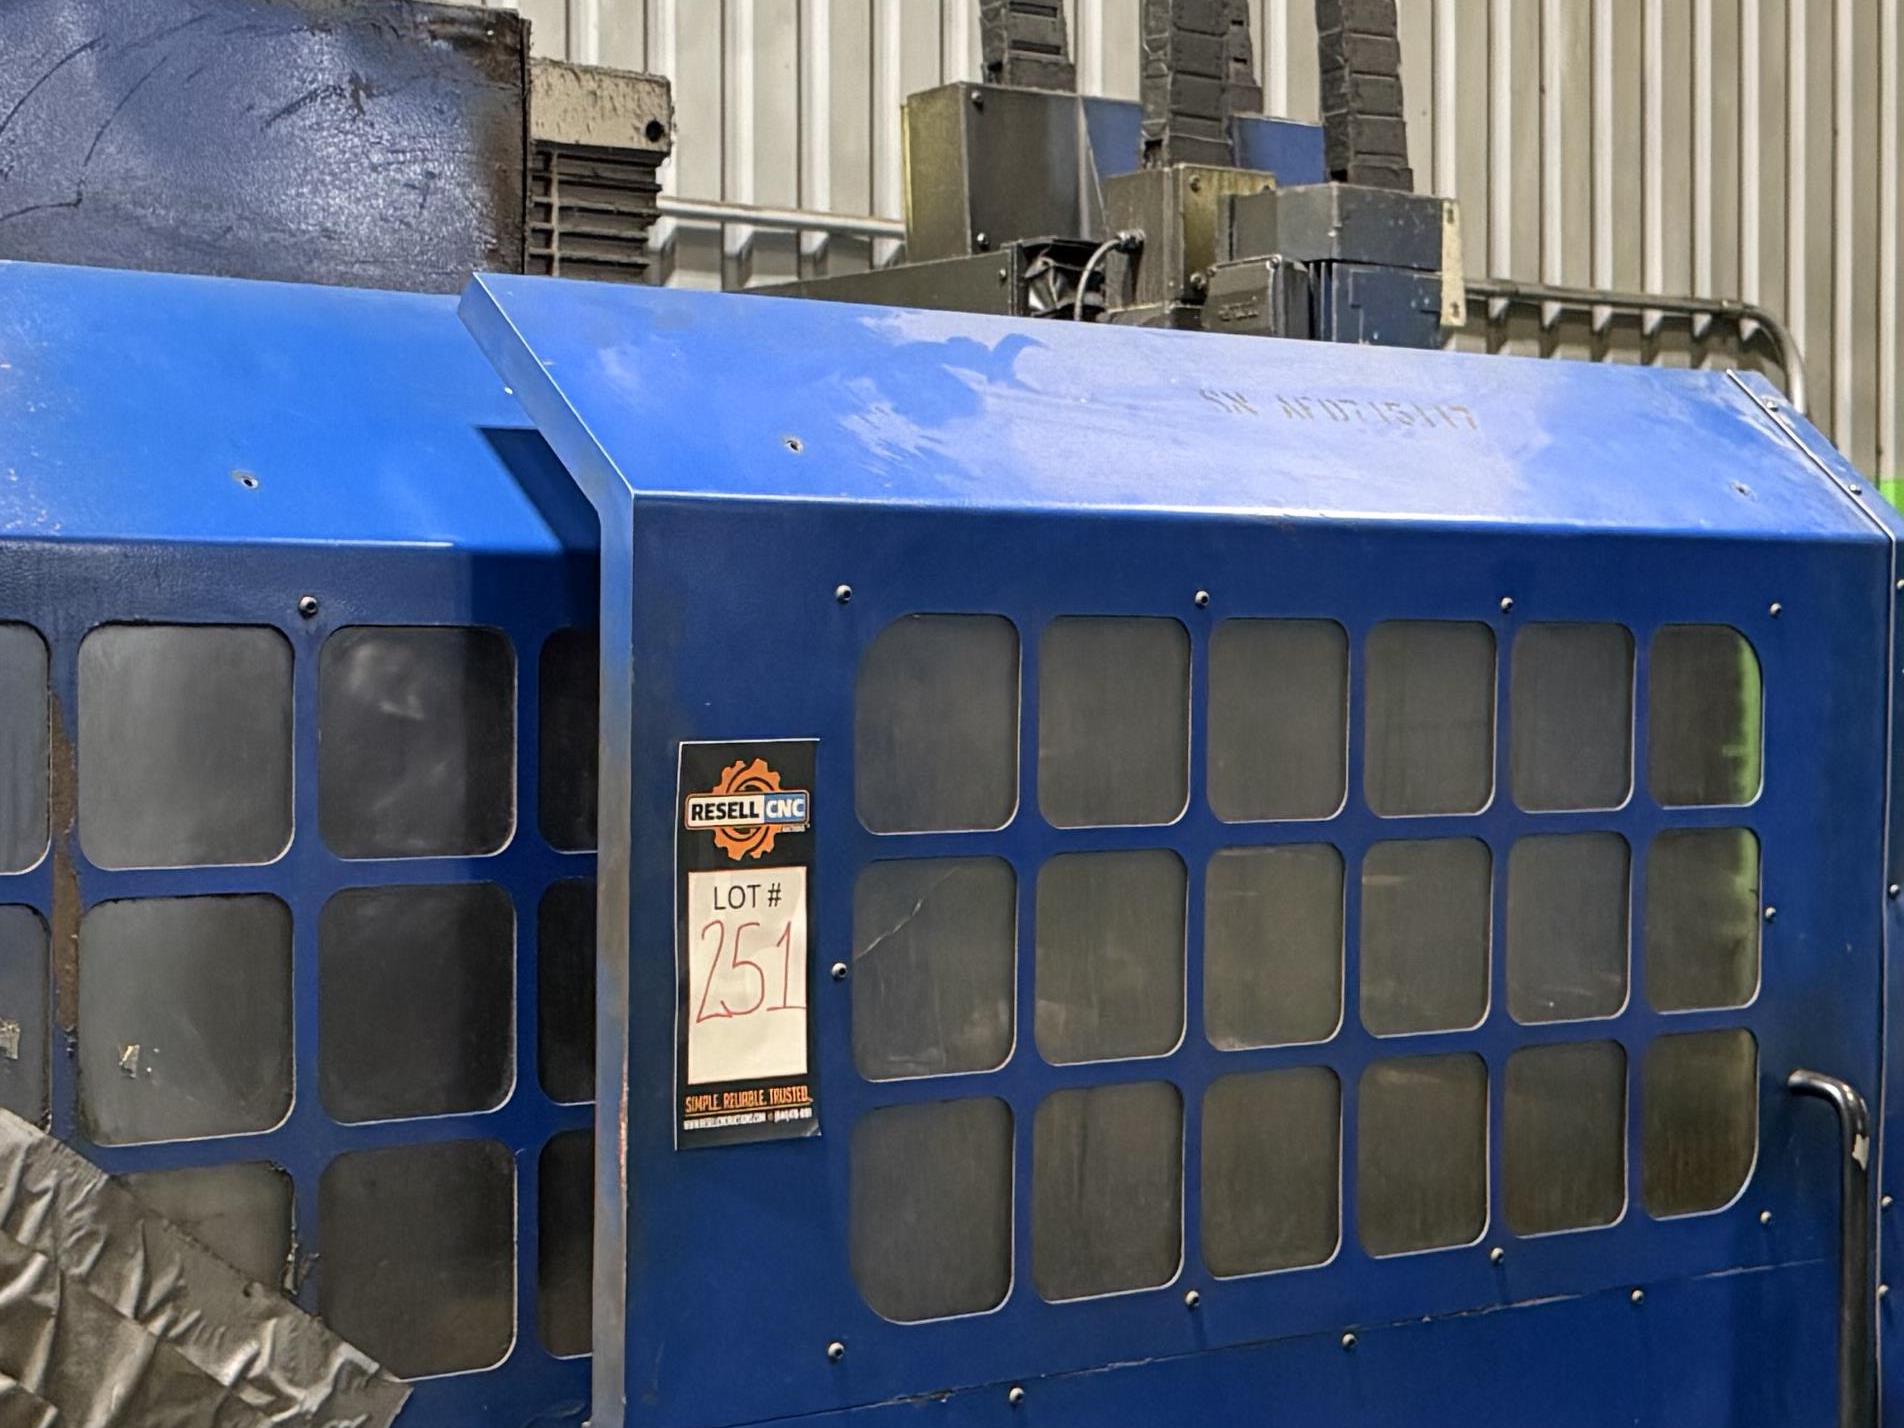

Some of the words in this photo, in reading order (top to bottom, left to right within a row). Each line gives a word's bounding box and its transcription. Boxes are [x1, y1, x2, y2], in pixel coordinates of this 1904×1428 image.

[690, 801, 760, 822] RESELL
[766, 798, 806, 819] CNC
[713, 884, 762, 911] LOT
[767, 882, 782, 909] #
[696, 919, 807, 1023] 251
[685, 1093, 722, 1113] SIMPLE.
[723, 1089, 767, 1109] RELIABLE.
